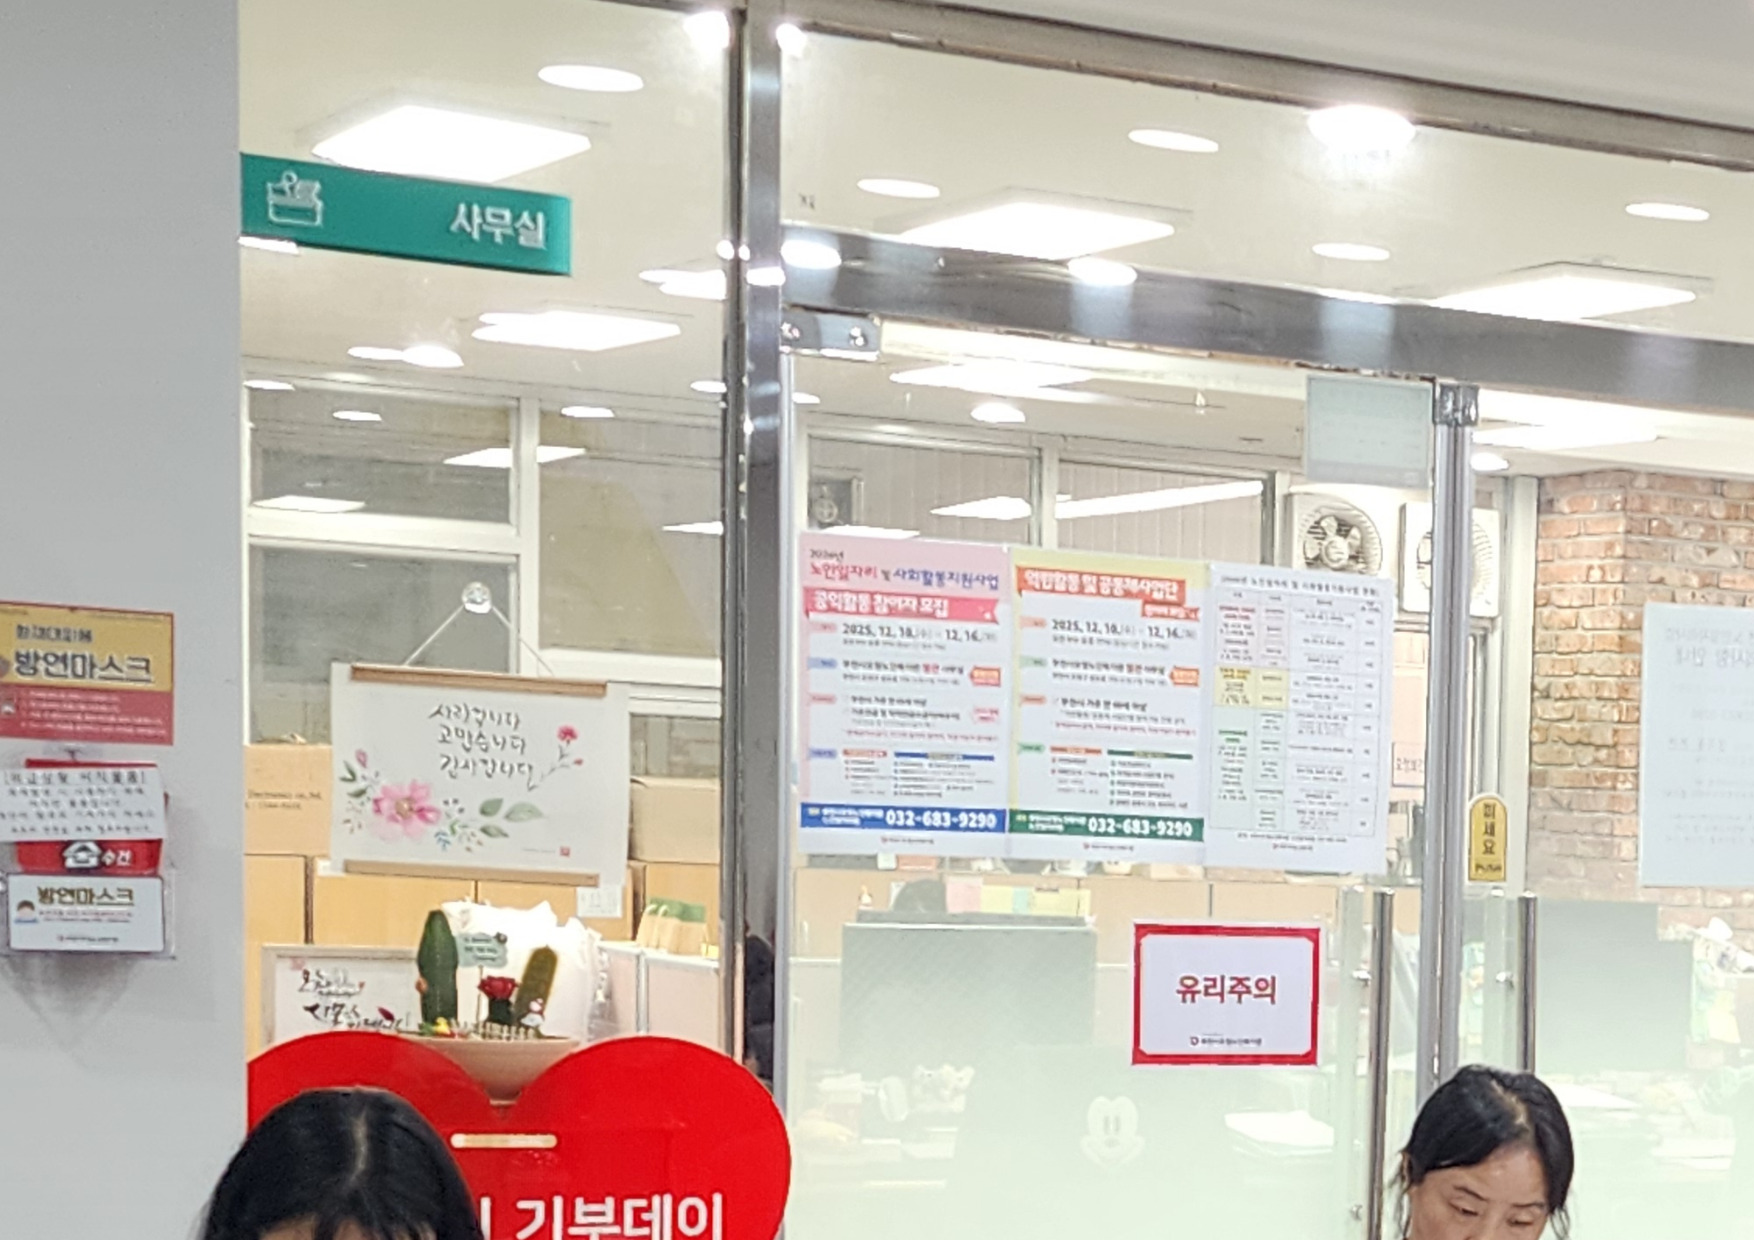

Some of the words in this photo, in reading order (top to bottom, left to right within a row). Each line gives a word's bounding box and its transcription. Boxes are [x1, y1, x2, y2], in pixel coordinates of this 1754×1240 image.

[451, 203, 546, 248] 사무실
[811, 562, 877, 581] 노인일자리
[893, 567, 998, 590] 사회활동지원사업
[1082, 574, 1097, 594] 및
[1099, 576, 1179, 601] 공동체사업단
[815, 589, 871, 613] 공익활동
[873, 592, 917, 616] 참여자
[920, 597, 948, 618] 모집
[15, 650, 153, 683] 방연마스크
[438, 723, 526, 755] 고맙습니다
[886, 809, 997, 829] 032-683-9290
[1088, 816, 1193, 837] 032-683-9290
[37, 887, 135, 906] 방연마스크
[1177, 975, 1277, 1005] 유리주의
